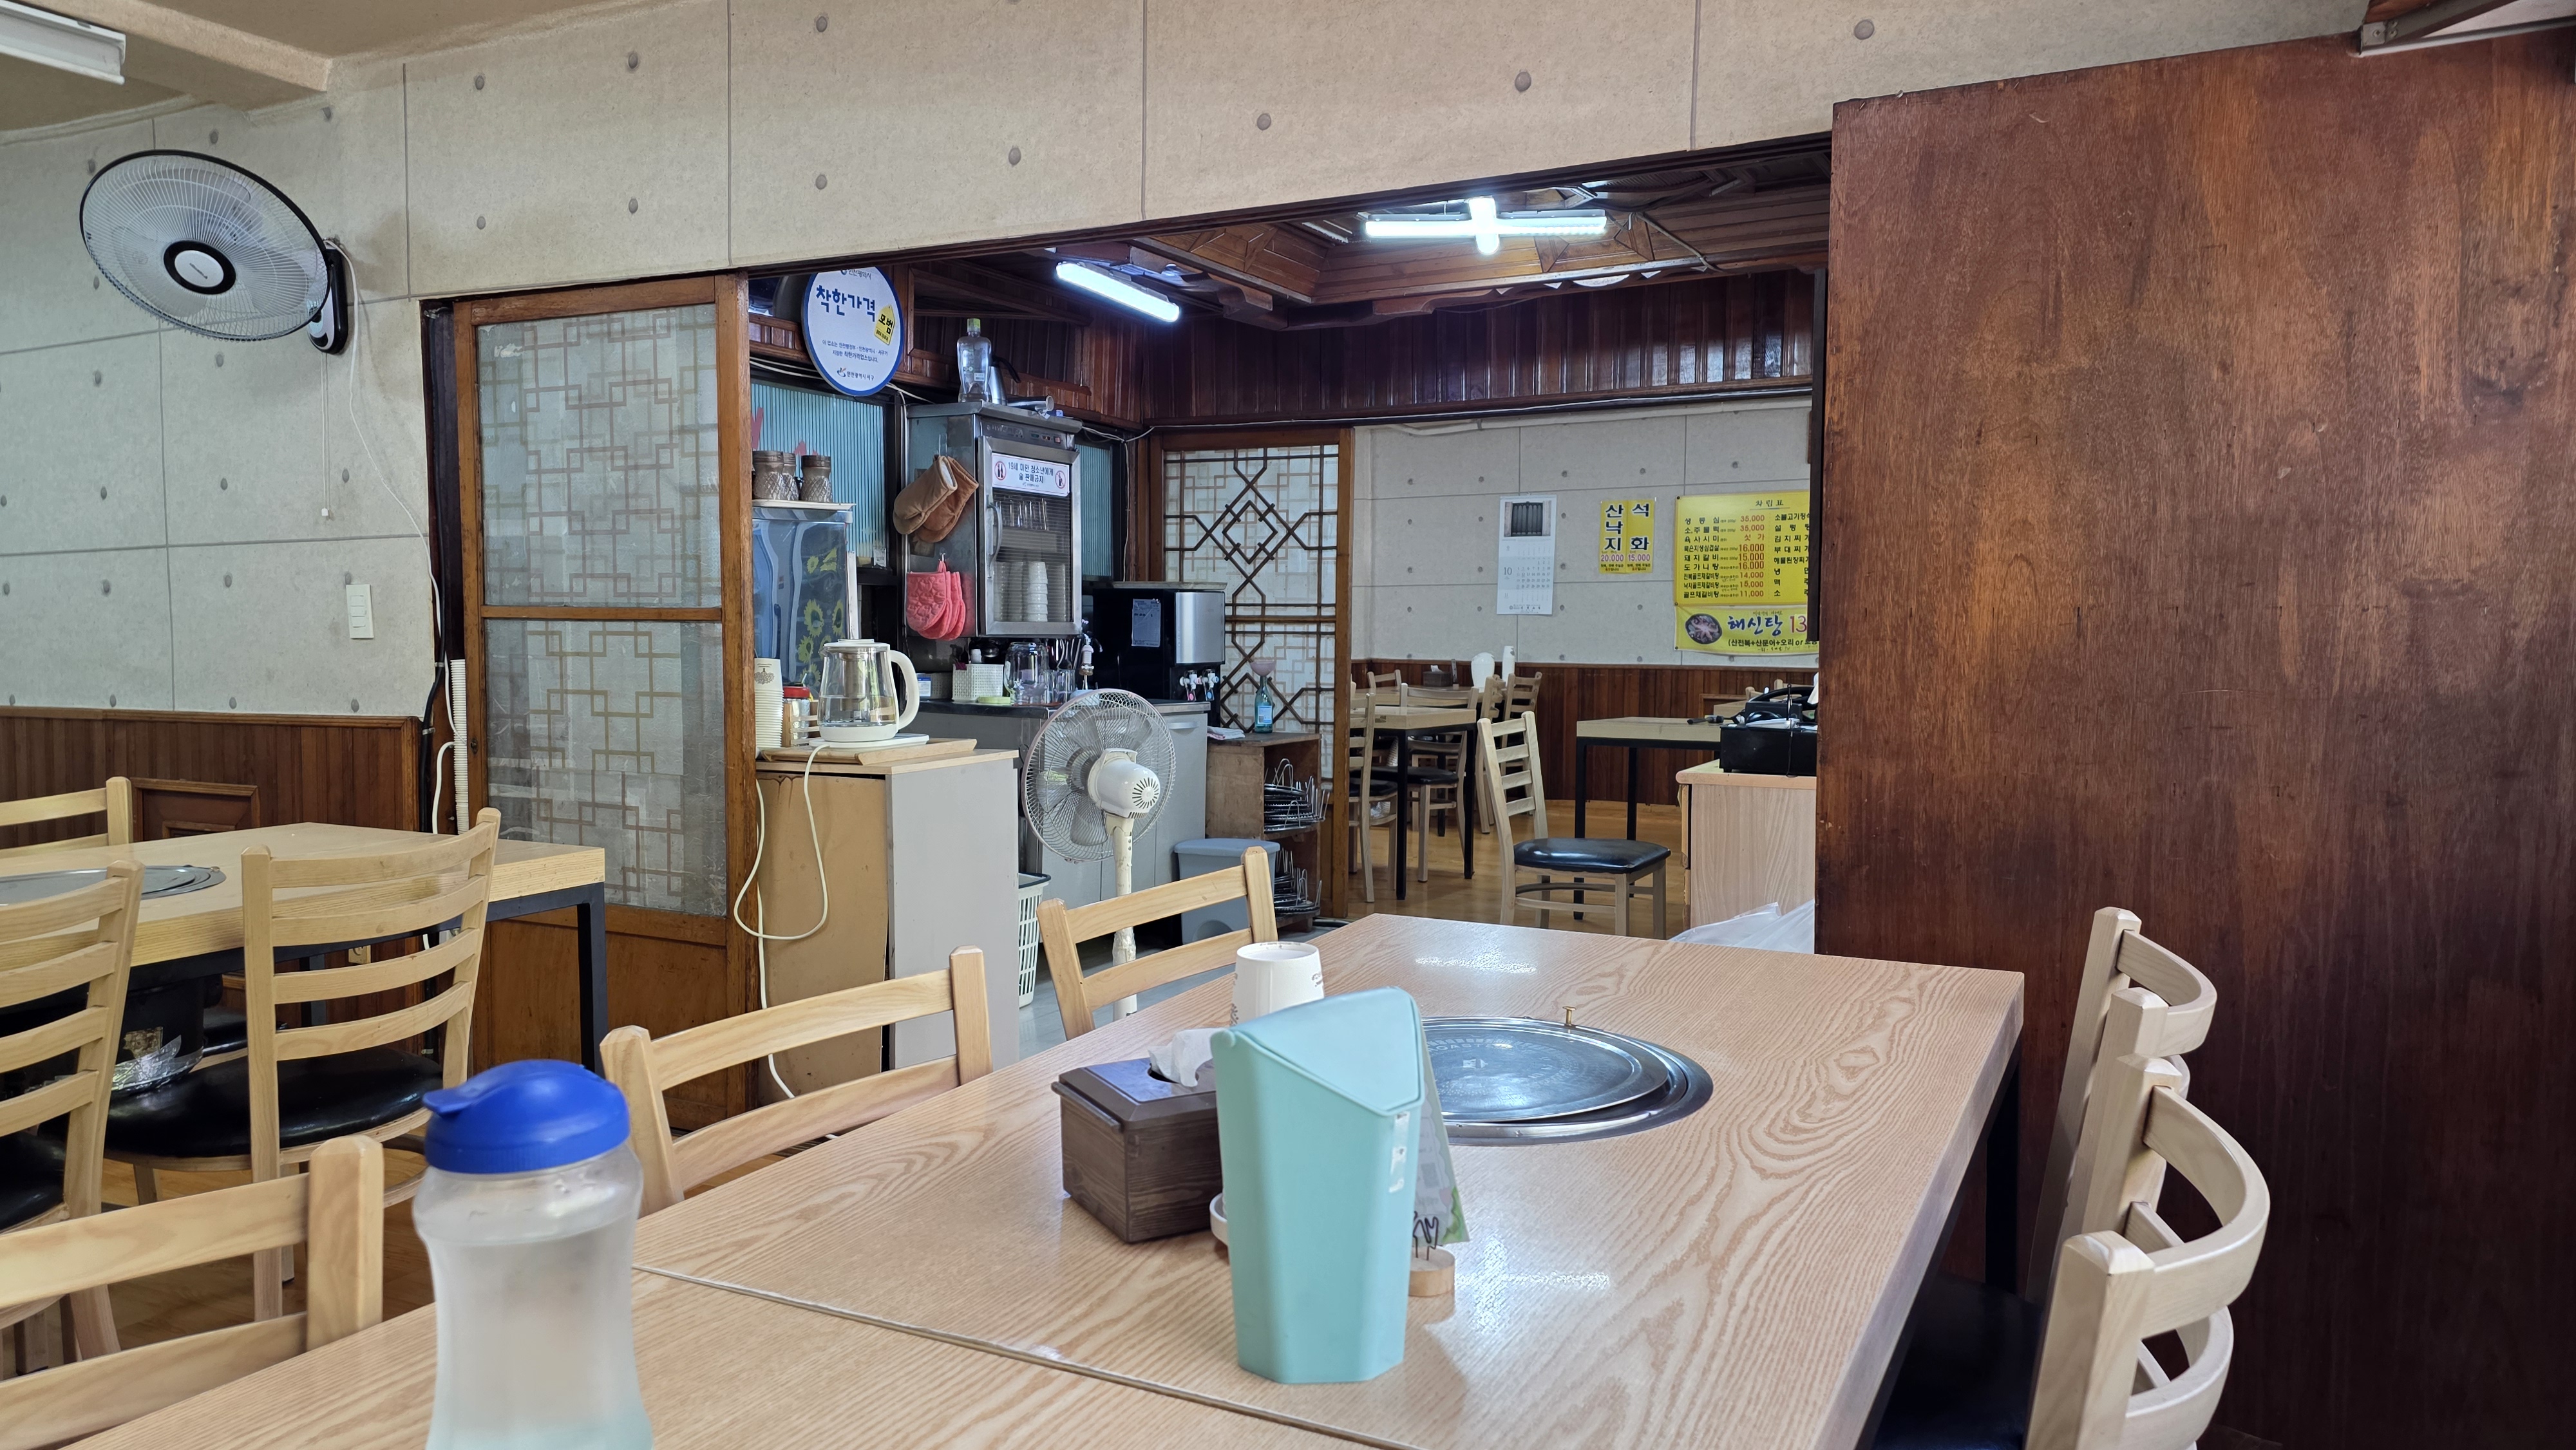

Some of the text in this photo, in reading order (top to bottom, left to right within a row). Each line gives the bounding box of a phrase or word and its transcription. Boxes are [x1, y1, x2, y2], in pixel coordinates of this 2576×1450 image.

[816, 285, 875, 322] 착한가격
[878, 314, 893, 335] 모범
[1008, 462, 1054, 476] 19세 미만 청소년에게
[1025, 473, 1043, 483] 판매금지
[1604, 504, 1624, 551] 산낙지
[1739, 544, 1765, 552] 16,000
[1601, 554, 1624, 563] 20,000
[1628, 553, 1650, 562] 15,000
[1739, 553, 1765, 561] 15,000
[1739, 561, 1765, 570] 16,000
[1504, 567, 1512, 576] 10
[1727, 616, 1783, 636] 해신탕
